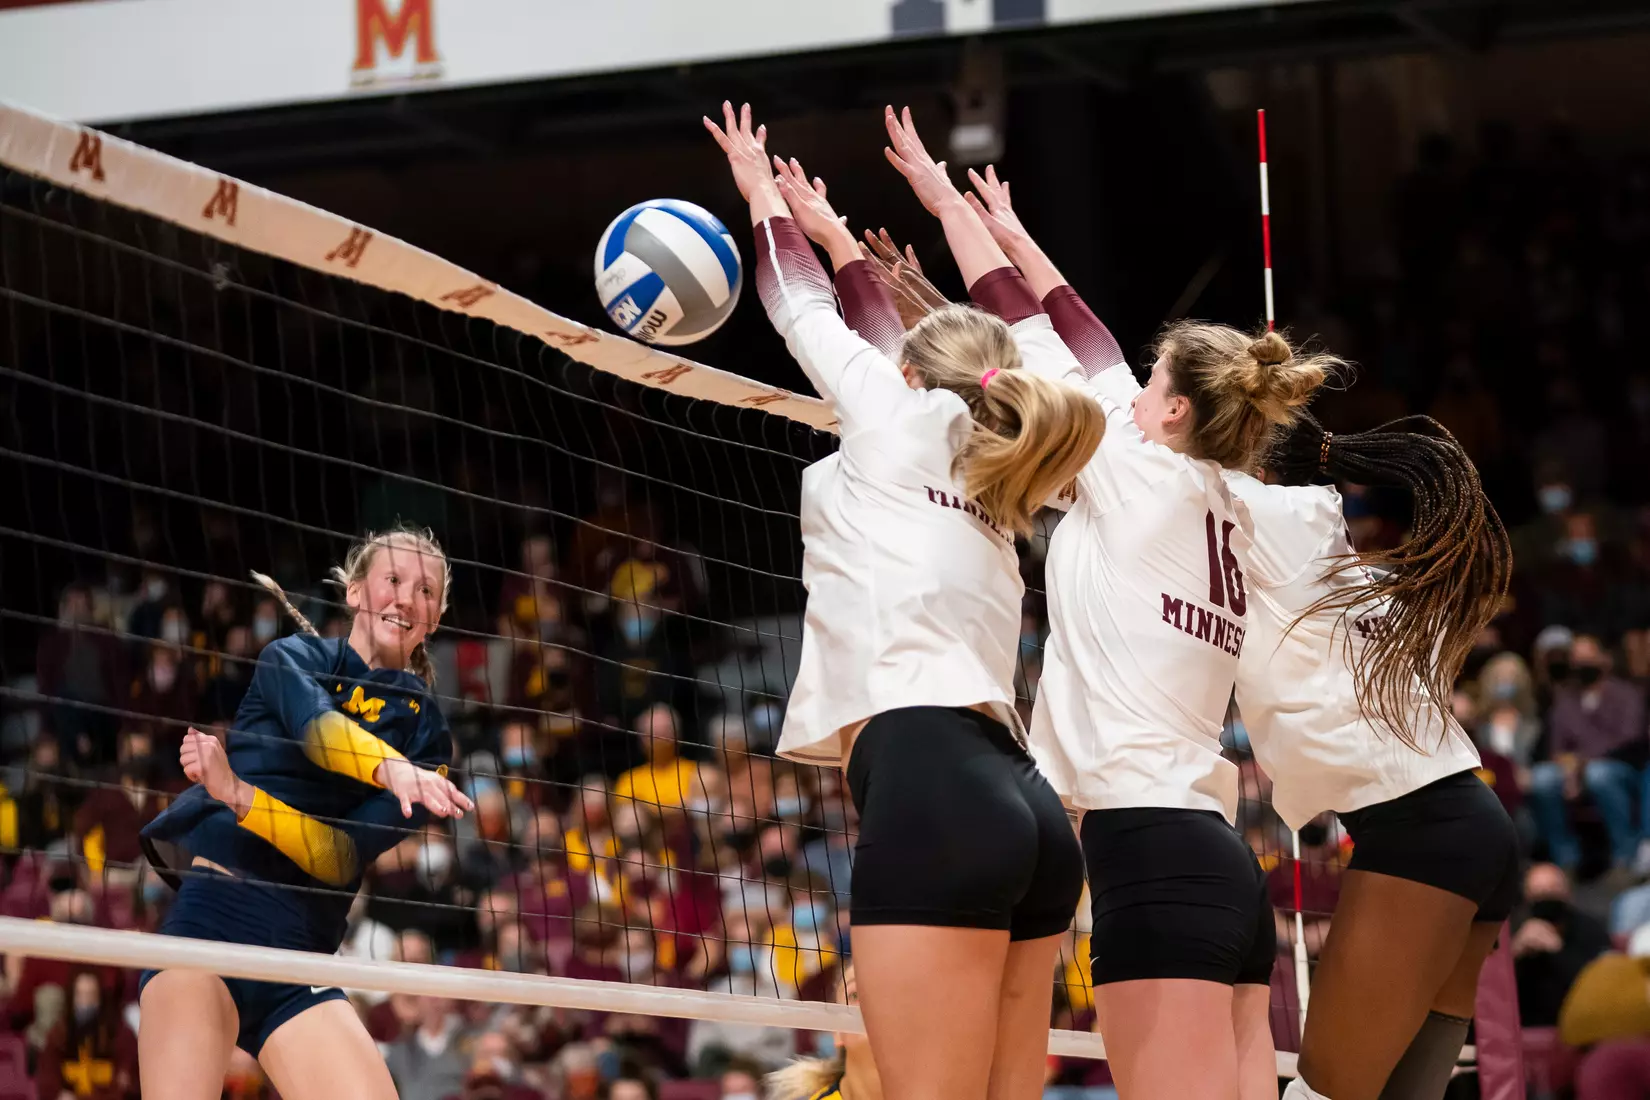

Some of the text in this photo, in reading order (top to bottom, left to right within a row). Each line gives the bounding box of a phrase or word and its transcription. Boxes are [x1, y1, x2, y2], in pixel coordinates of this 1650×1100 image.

[351, 0, 443, 74] M
[69, 131, 105, 181] M
[202, 178, 239, 227] M
[324, 226, 375, 268] M
[1205, 508, 1247, 617] 16
[1161, 592, 1246, 659] MINNES
[341, 685, 387, 723] M
